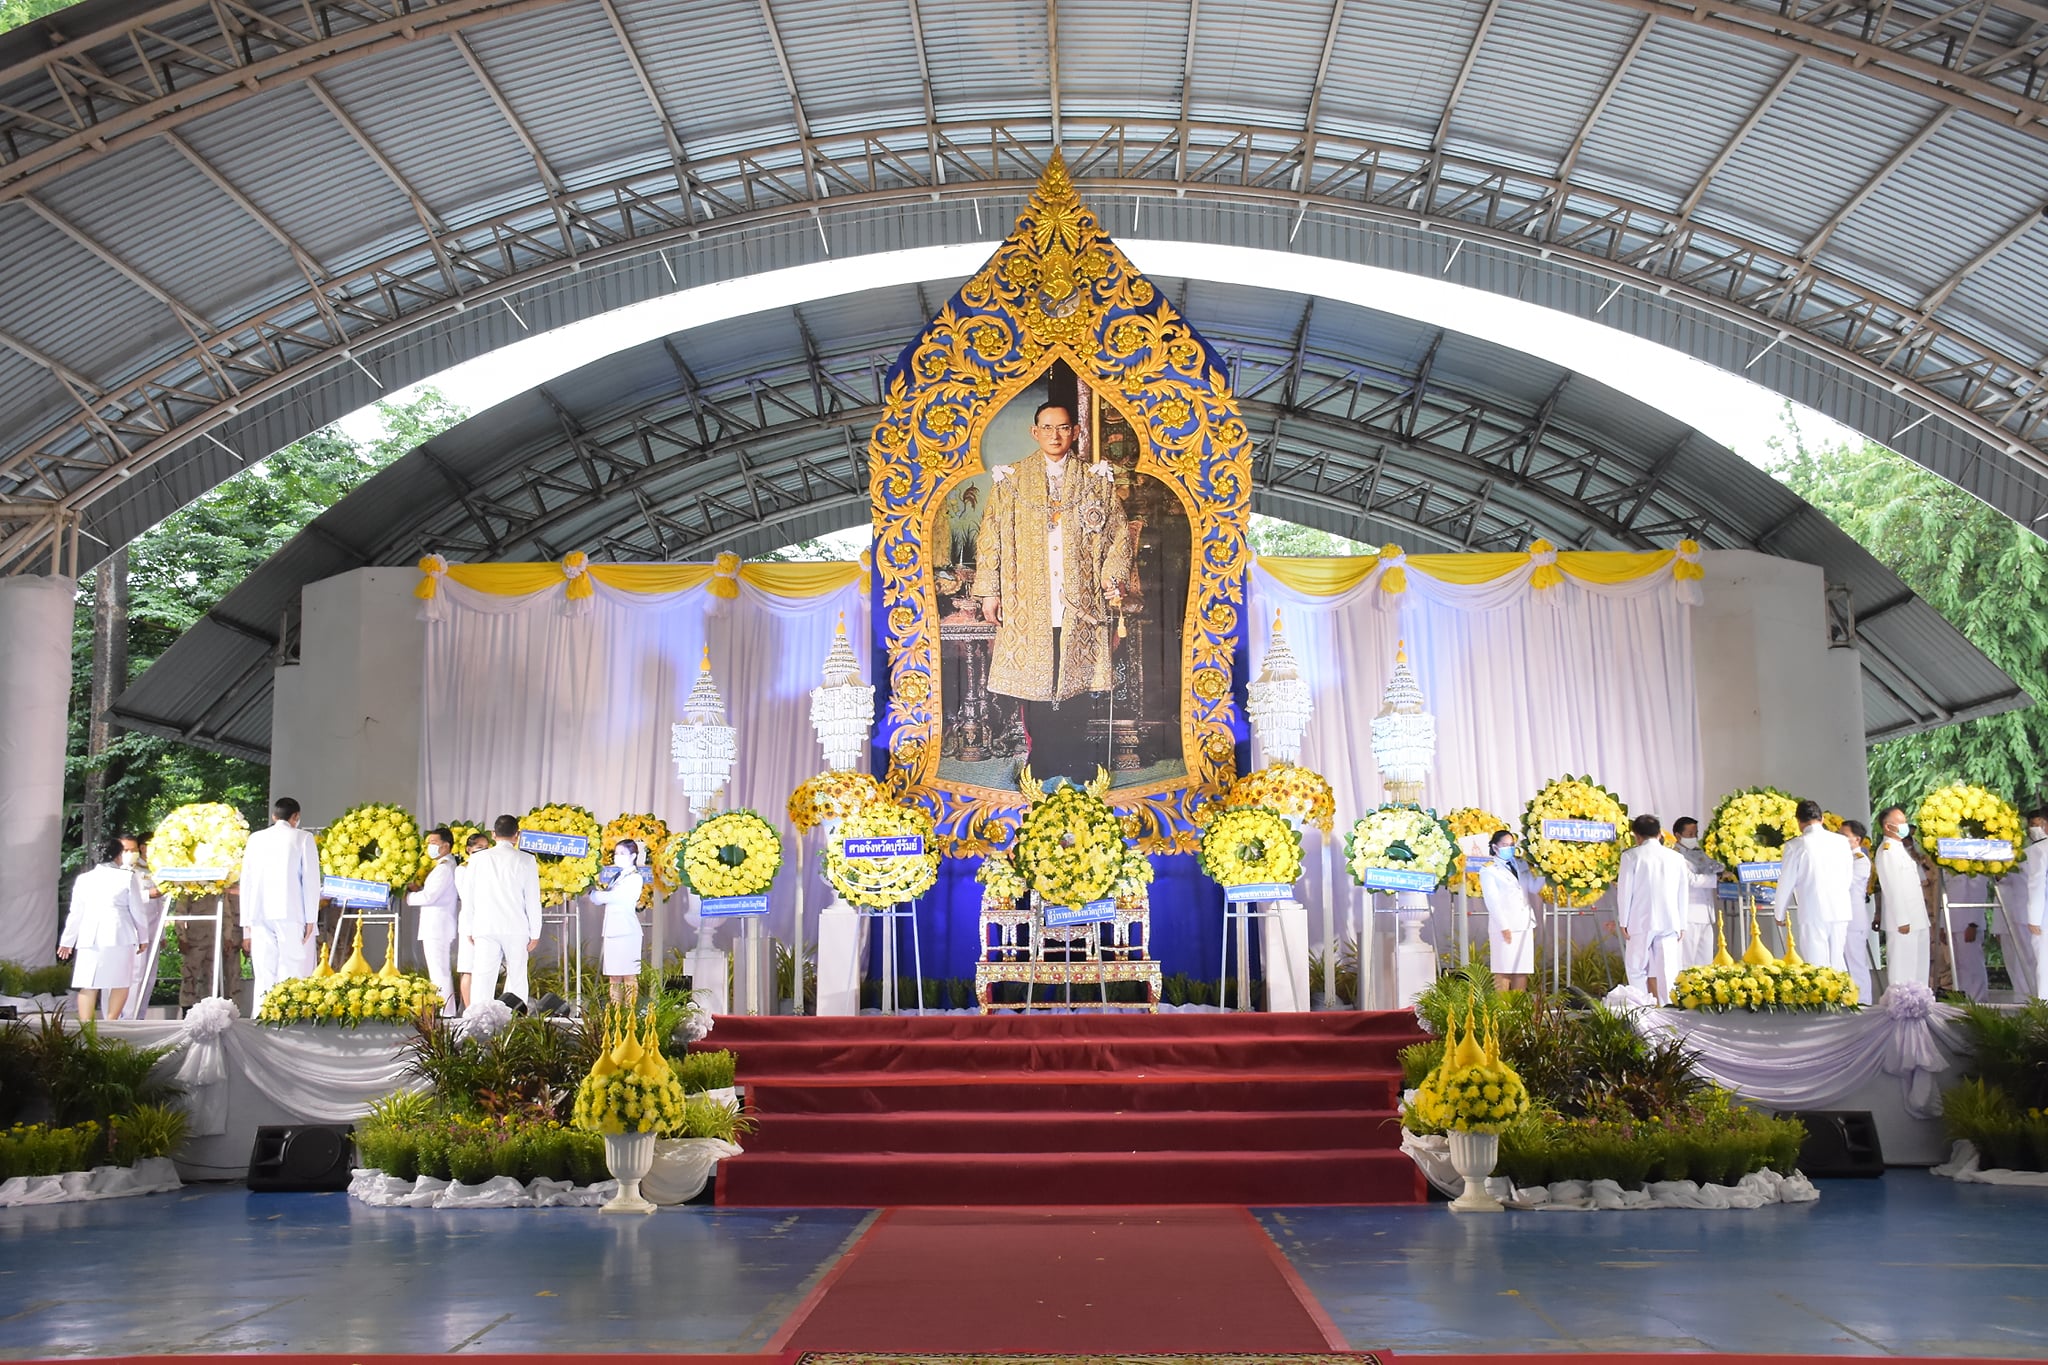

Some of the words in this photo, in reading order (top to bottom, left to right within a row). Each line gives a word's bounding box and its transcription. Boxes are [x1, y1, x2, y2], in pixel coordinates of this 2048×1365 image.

[848, 838, 918, 856] ศาลจังหวัดบุรีรัมย์
[1047, 903, 1114, 923] ผู้ว่าราชการจงหวัดบุรีรัมย์
